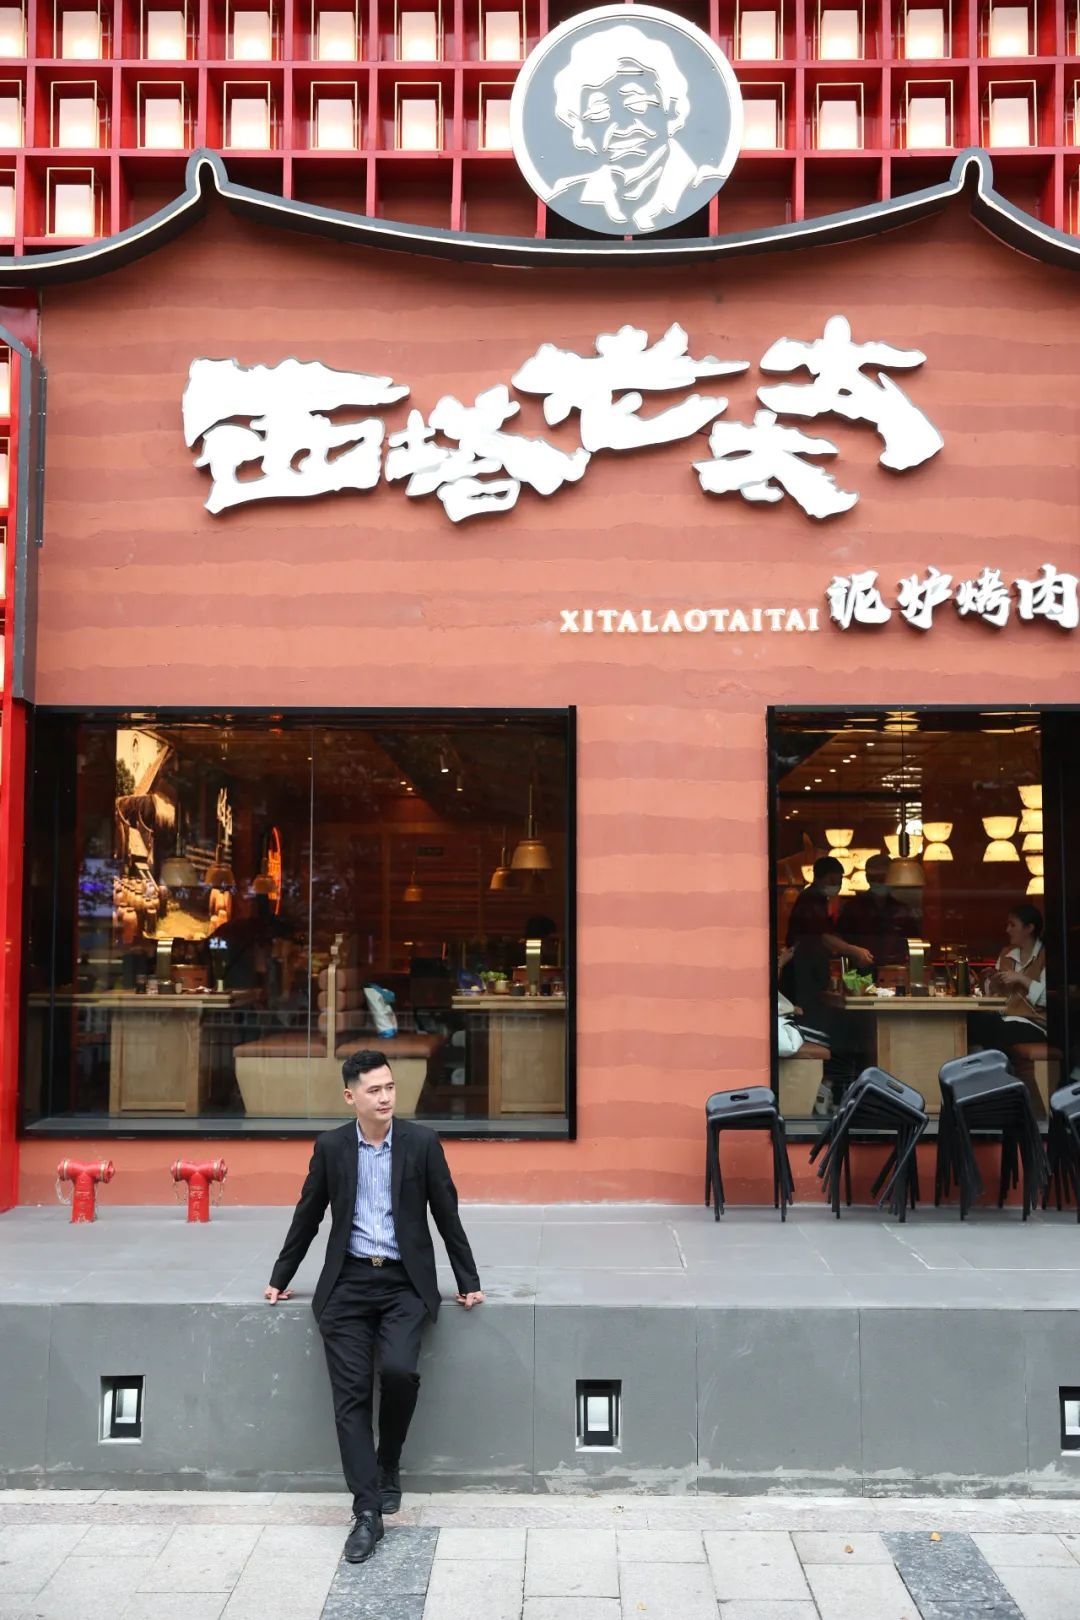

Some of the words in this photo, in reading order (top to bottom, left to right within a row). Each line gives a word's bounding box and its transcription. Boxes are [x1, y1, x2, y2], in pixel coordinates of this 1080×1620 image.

[826, 563, 1080, 631] 泥炉烤肉
[559, 608, 820, 634] XITALAOTAITAI
